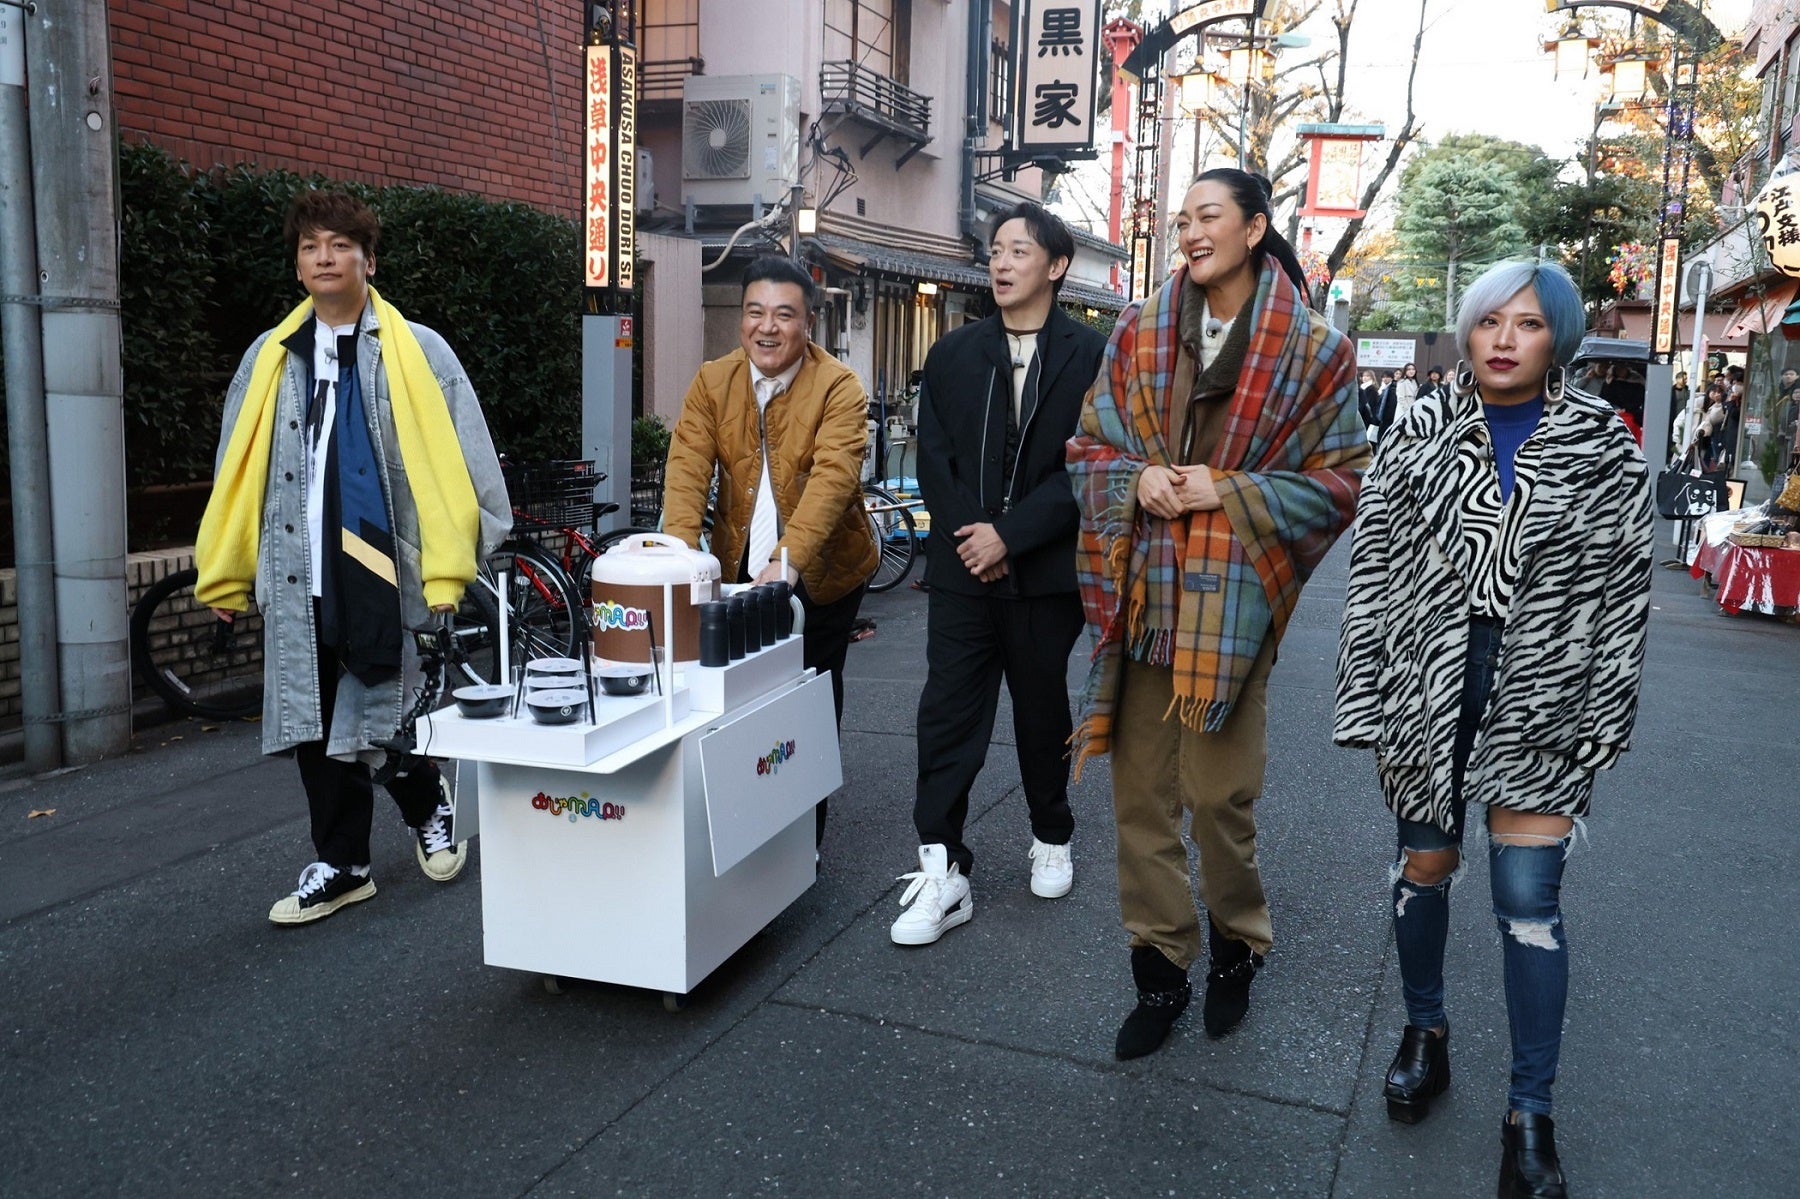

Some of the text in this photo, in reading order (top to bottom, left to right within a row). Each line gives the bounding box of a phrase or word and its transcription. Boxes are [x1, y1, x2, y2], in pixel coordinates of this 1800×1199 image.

[1032, 7, 1083, 128] 黒家
[589, 57, 607, 281] 浅草中央通り
[620, 51, 633, 286] ASAKUSA CHUO DORI St.
[1658, 245, 1676, 349] 浅草中央通り
